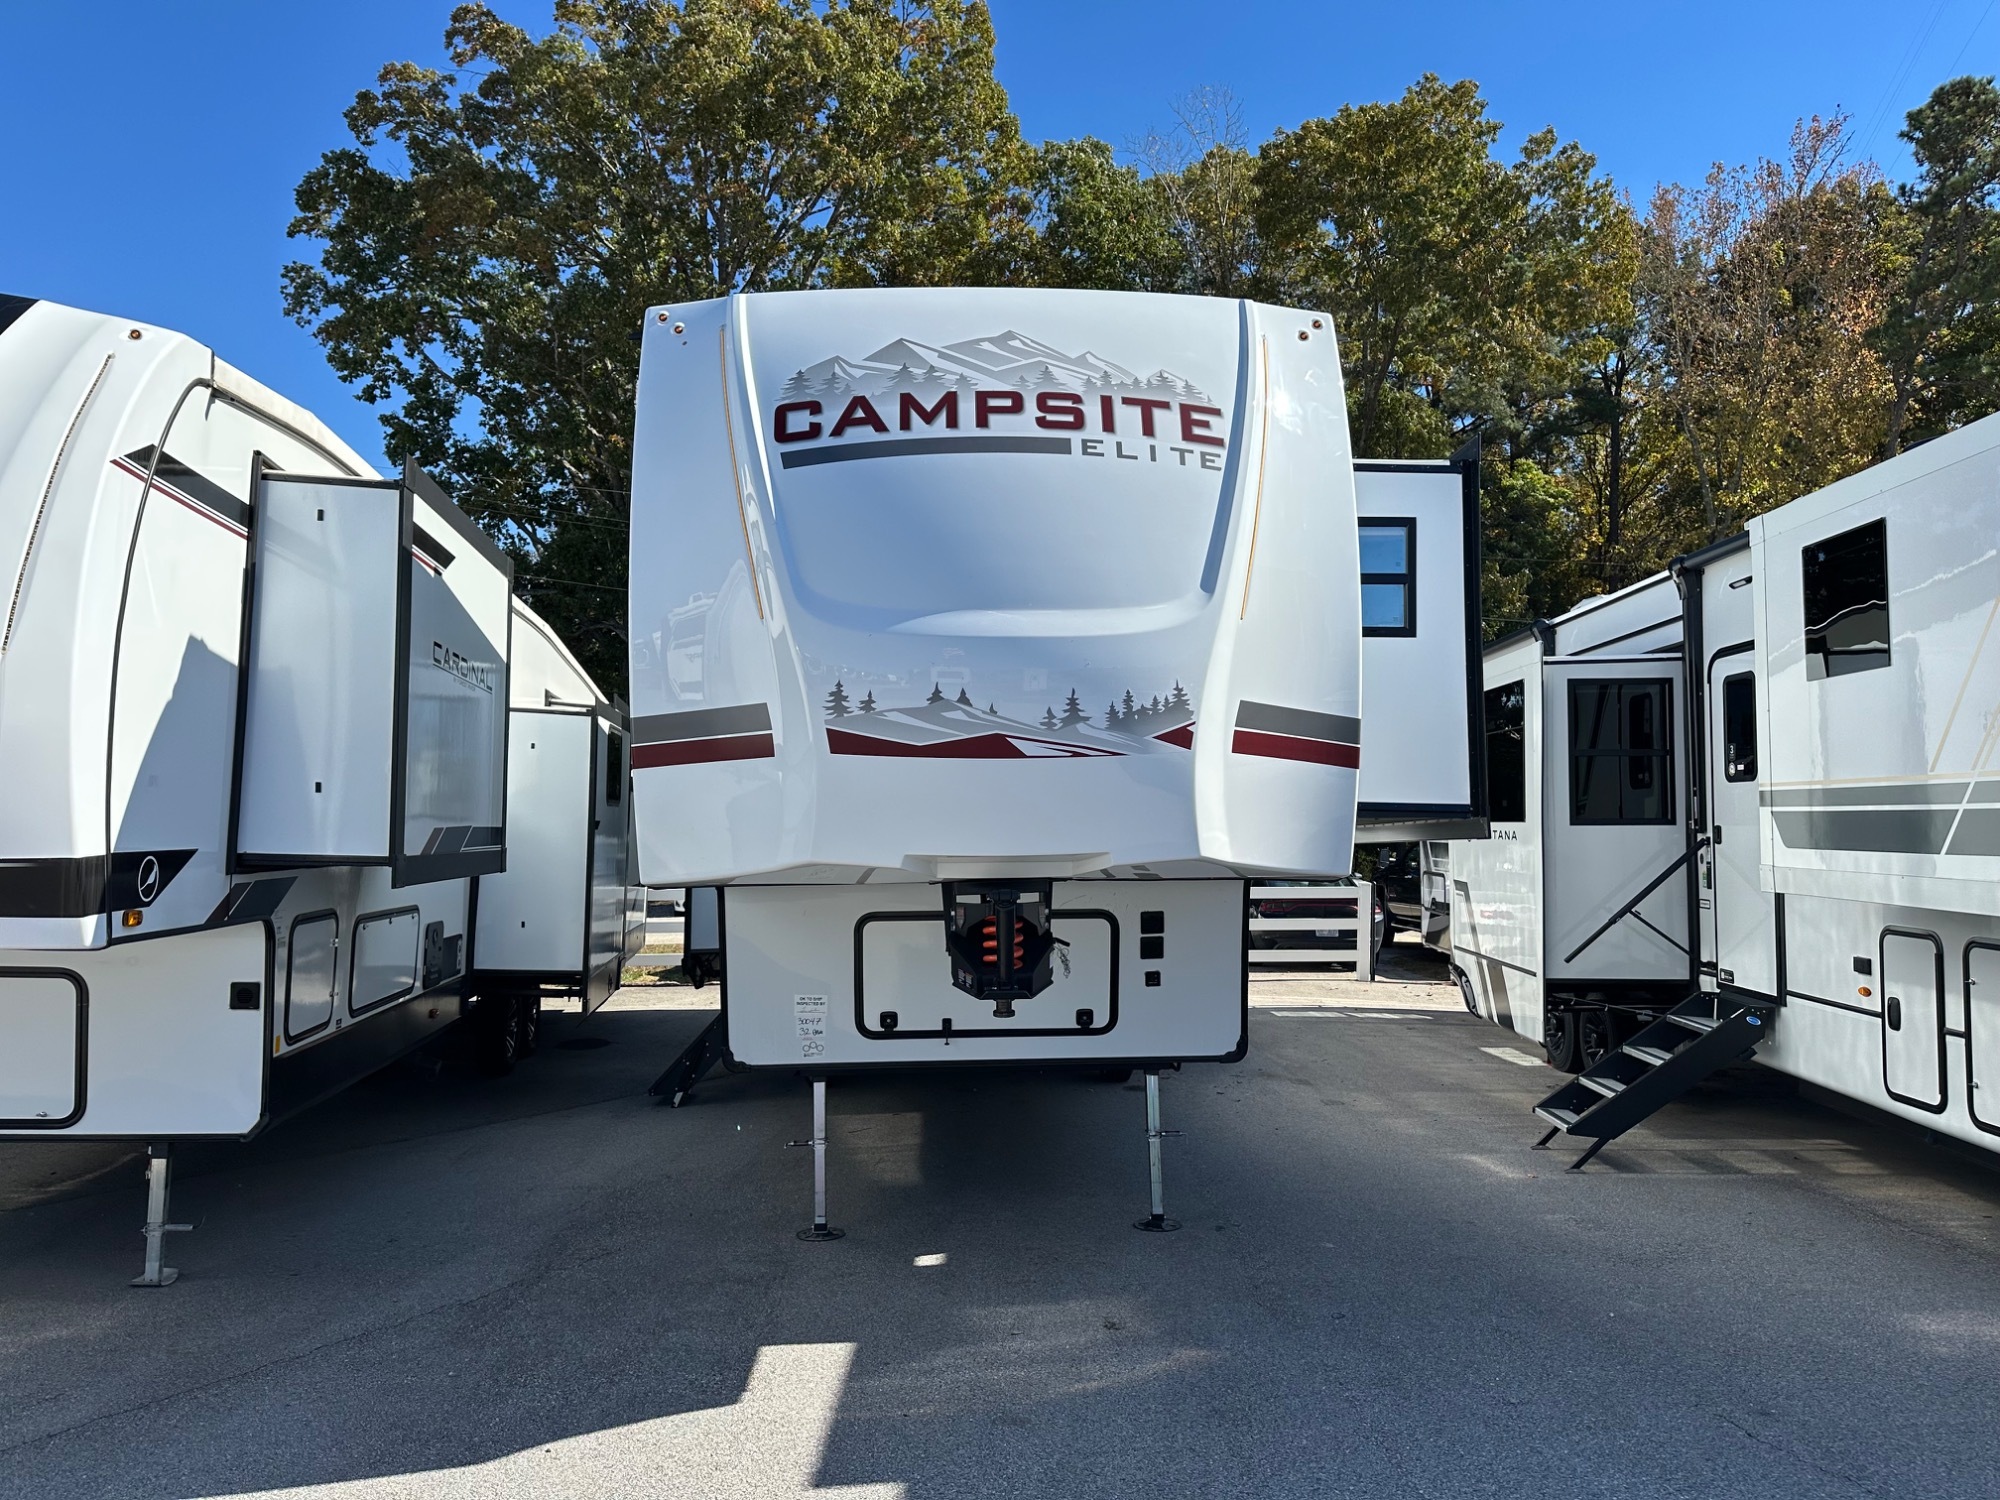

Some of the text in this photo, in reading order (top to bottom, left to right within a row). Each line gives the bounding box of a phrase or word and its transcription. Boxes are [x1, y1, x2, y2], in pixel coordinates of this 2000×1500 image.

[773, 390, 1226, 448] CAMPSITE
[1081, 438, 1223, 471] ELITE
[432, 640, 493, 692] CARDINAL
[1492, 829, 1518, 841] TANA
